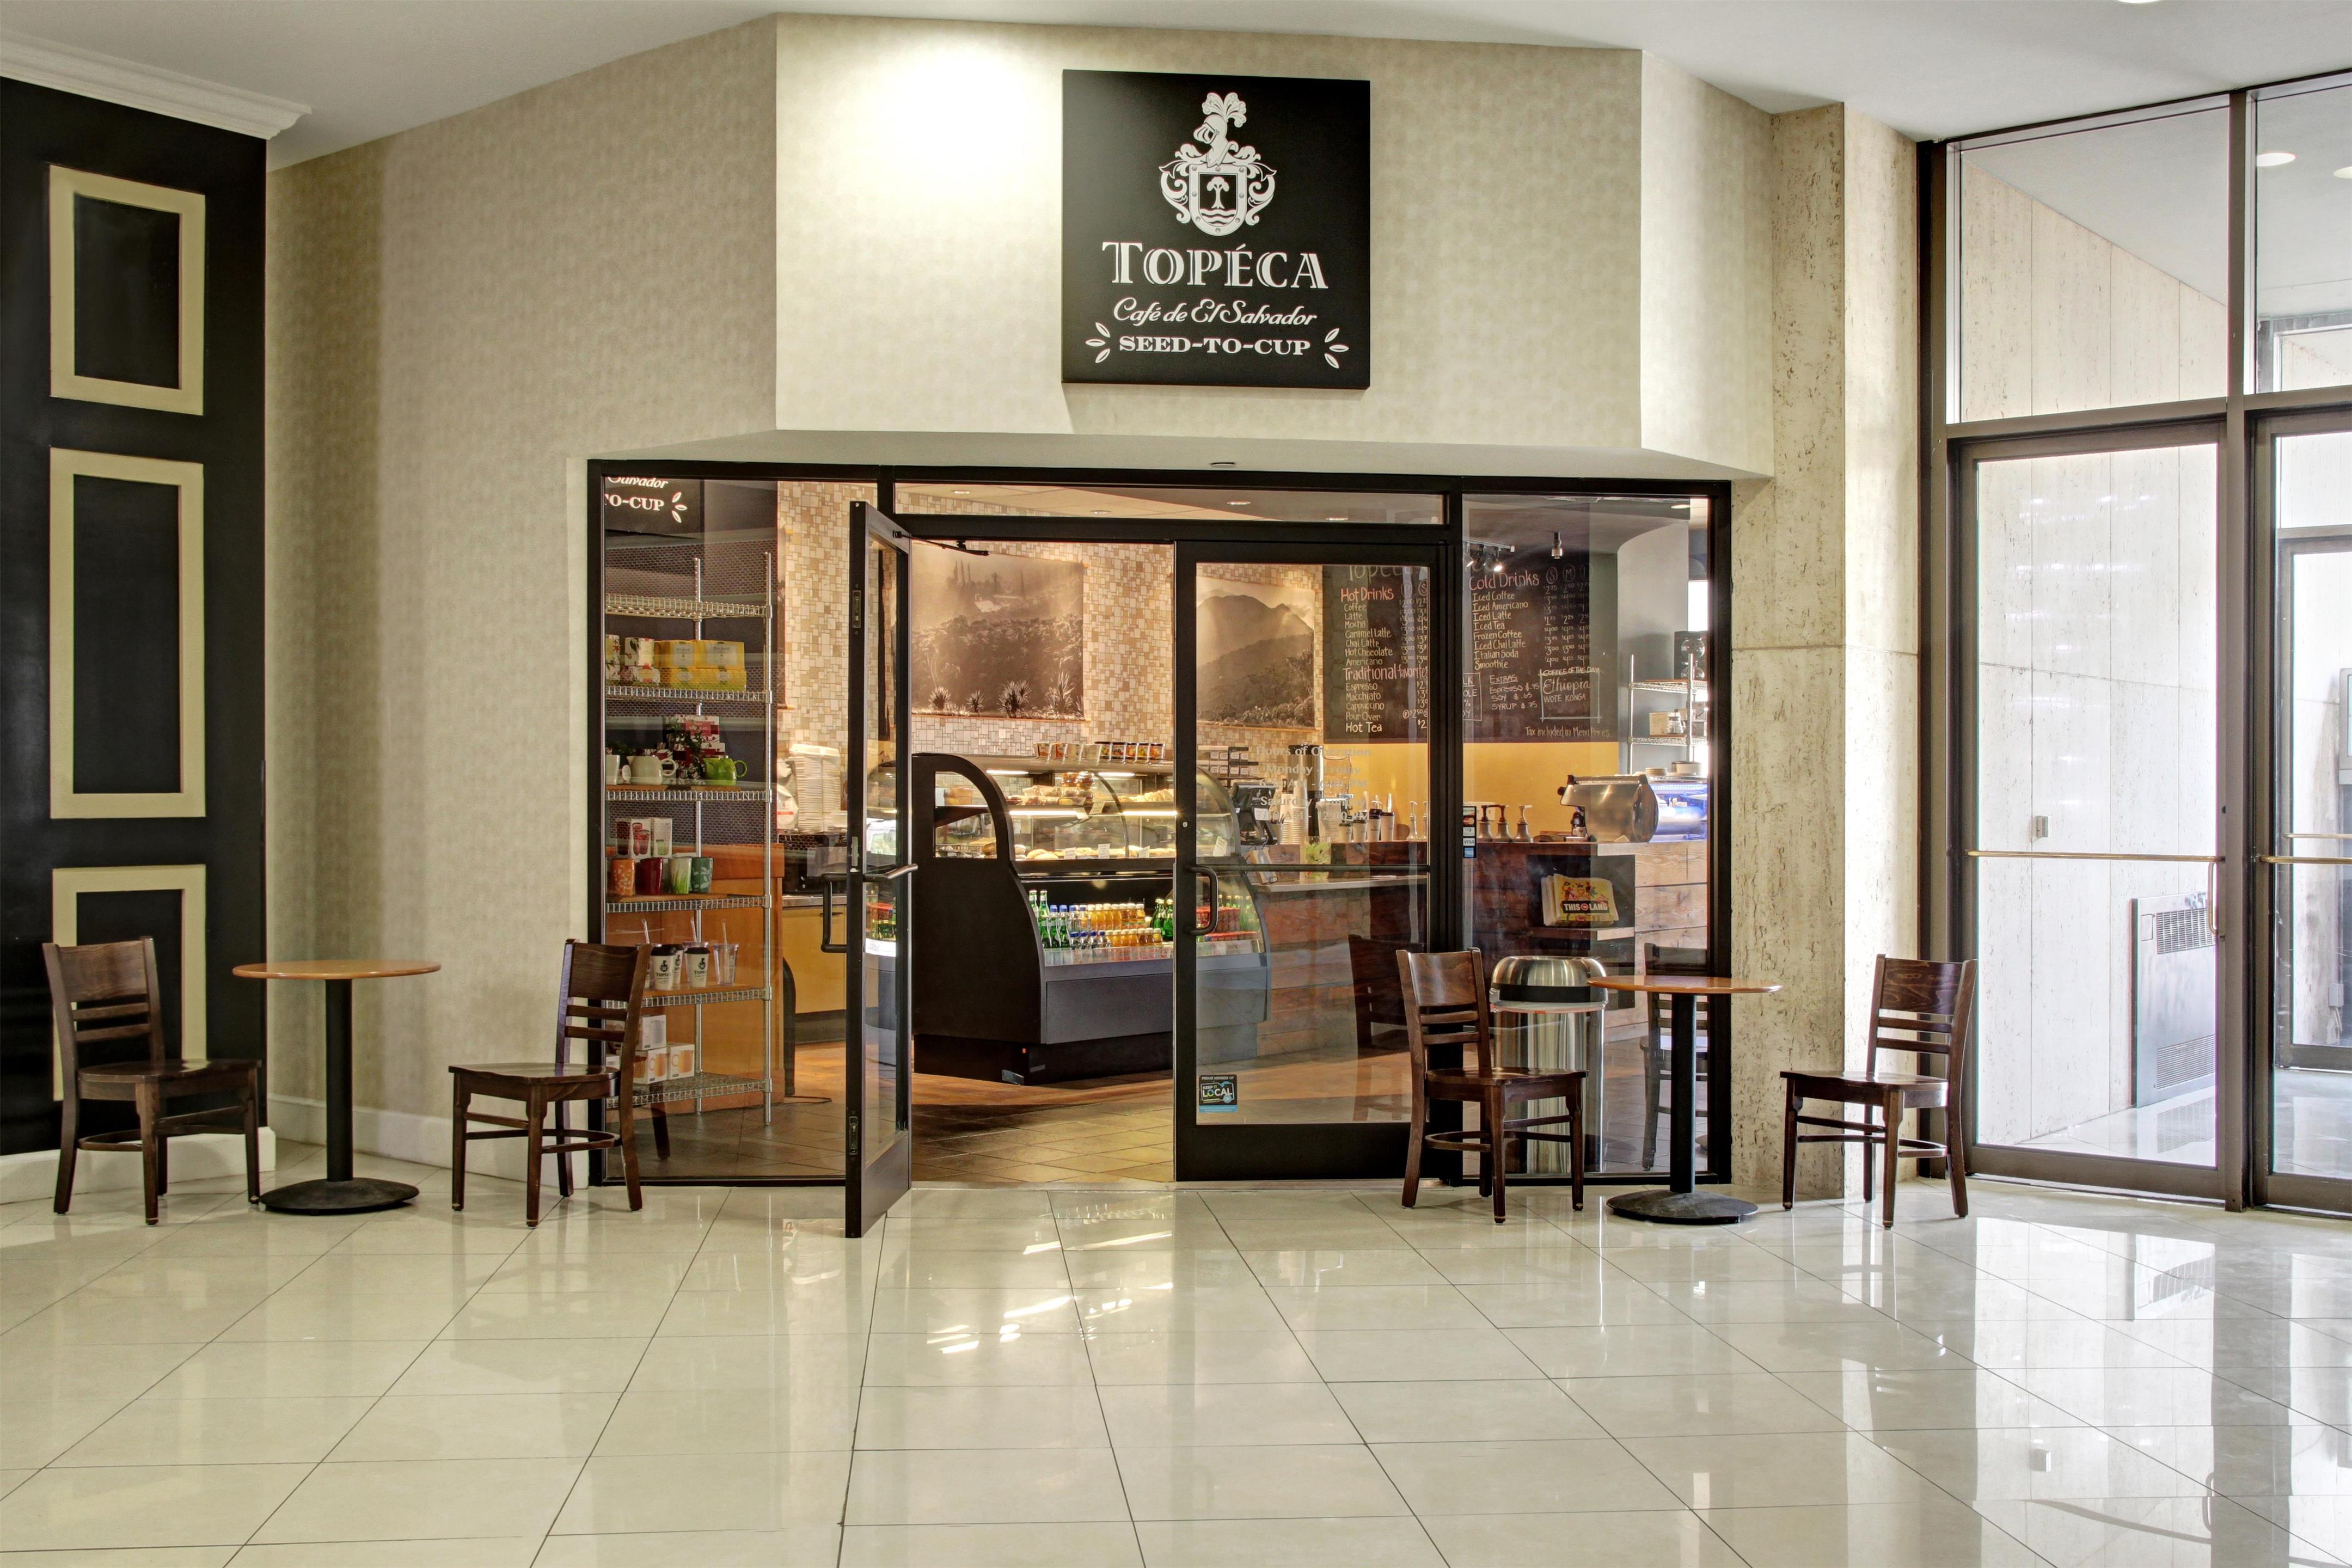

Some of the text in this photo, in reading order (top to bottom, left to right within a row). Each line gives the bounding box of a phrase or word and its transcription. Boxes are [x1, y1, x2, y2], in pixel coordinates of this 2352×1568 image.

[1101, 241, 1329, 289] TOPÉCA
[1113, 297, 1318, 327] Café de El Salvador
[1119, 336, 1311, 356] SEED-TO-CUP
[1469, 574, 1496, 591] Cold
[1499, 571, 1539, 587] Drinks
[1340, 587, 1359, 602] Hot
[1361, 586, 1394, 601] Drinks
[1473, 592, 1490, 602] Iced
[1492, 591, 1515, 601] Coffee
[1344, 602, 1367, 612] Coffee
[1472, 604, 1490, 612] Iced
[1492, 601, 1528, 611] Americano
[1344, 612, 1362, 621] Latte
[1473, 613, 1490, 622] Iced
[1492, 611, 1511, 620] Latte
[1344, 620, 1366, 629] Mocha
[1473, 622, 1491, 631] Iced
[1493, 621, 1505, 630] Tea
[1345, 628, 1373, 639] Caramel
[1374, 627, 1392, 638] Latte
[1473, 632, 1497, 641] Frozen
[1498, 630, 1522, 639] Coffee
[1345, 639, 1359, 648] Chai
[1361, 638, 1380, 648] Latte
[1474, 641, 1492, 651] Iced
[1493, 640, 1508, 650] Chai
[1508, 639, 1526, 648] Latte
[1345, 648, 1358, 657] Hot
[1358, 647, 1393, 657] Chocolate
[1474, 651, 1500, 660] Italian
[1500, 650, 1518, 658] Soda
[1345, 658, 1383, 666] Americano
[1474, 659, 1508, 670] Smoothie
[1343, 663, 1397, 682] Traditional
[1346, 682, 1378, 693] Espresso
[1543, 678, 1590, 695] Ethiopia
[1346, 691, 1381, 701] Macchiato
[1544, 695, 1562, 703] WOTE
[1346, 702, 1385, 713] Cappuccino
[1491, 702, 1517, 710] SYRUP
[1346, 712, 1361, 721] Pour
[1362, 711, 1381, 721] Over
[1346, 722, 1363, 732] Hot
[1365, 722, 1382, 733] Tea
[1525, 727, 1535, 736] Tax
[1538, 726, 1564, 738] included
[1565, 727, 1571, 737] in
[1572, 727, 1590, 737] Menu
[1295, 745, 1309, 756] of
[1202, 1087, 1233, 1098] LOCAL
